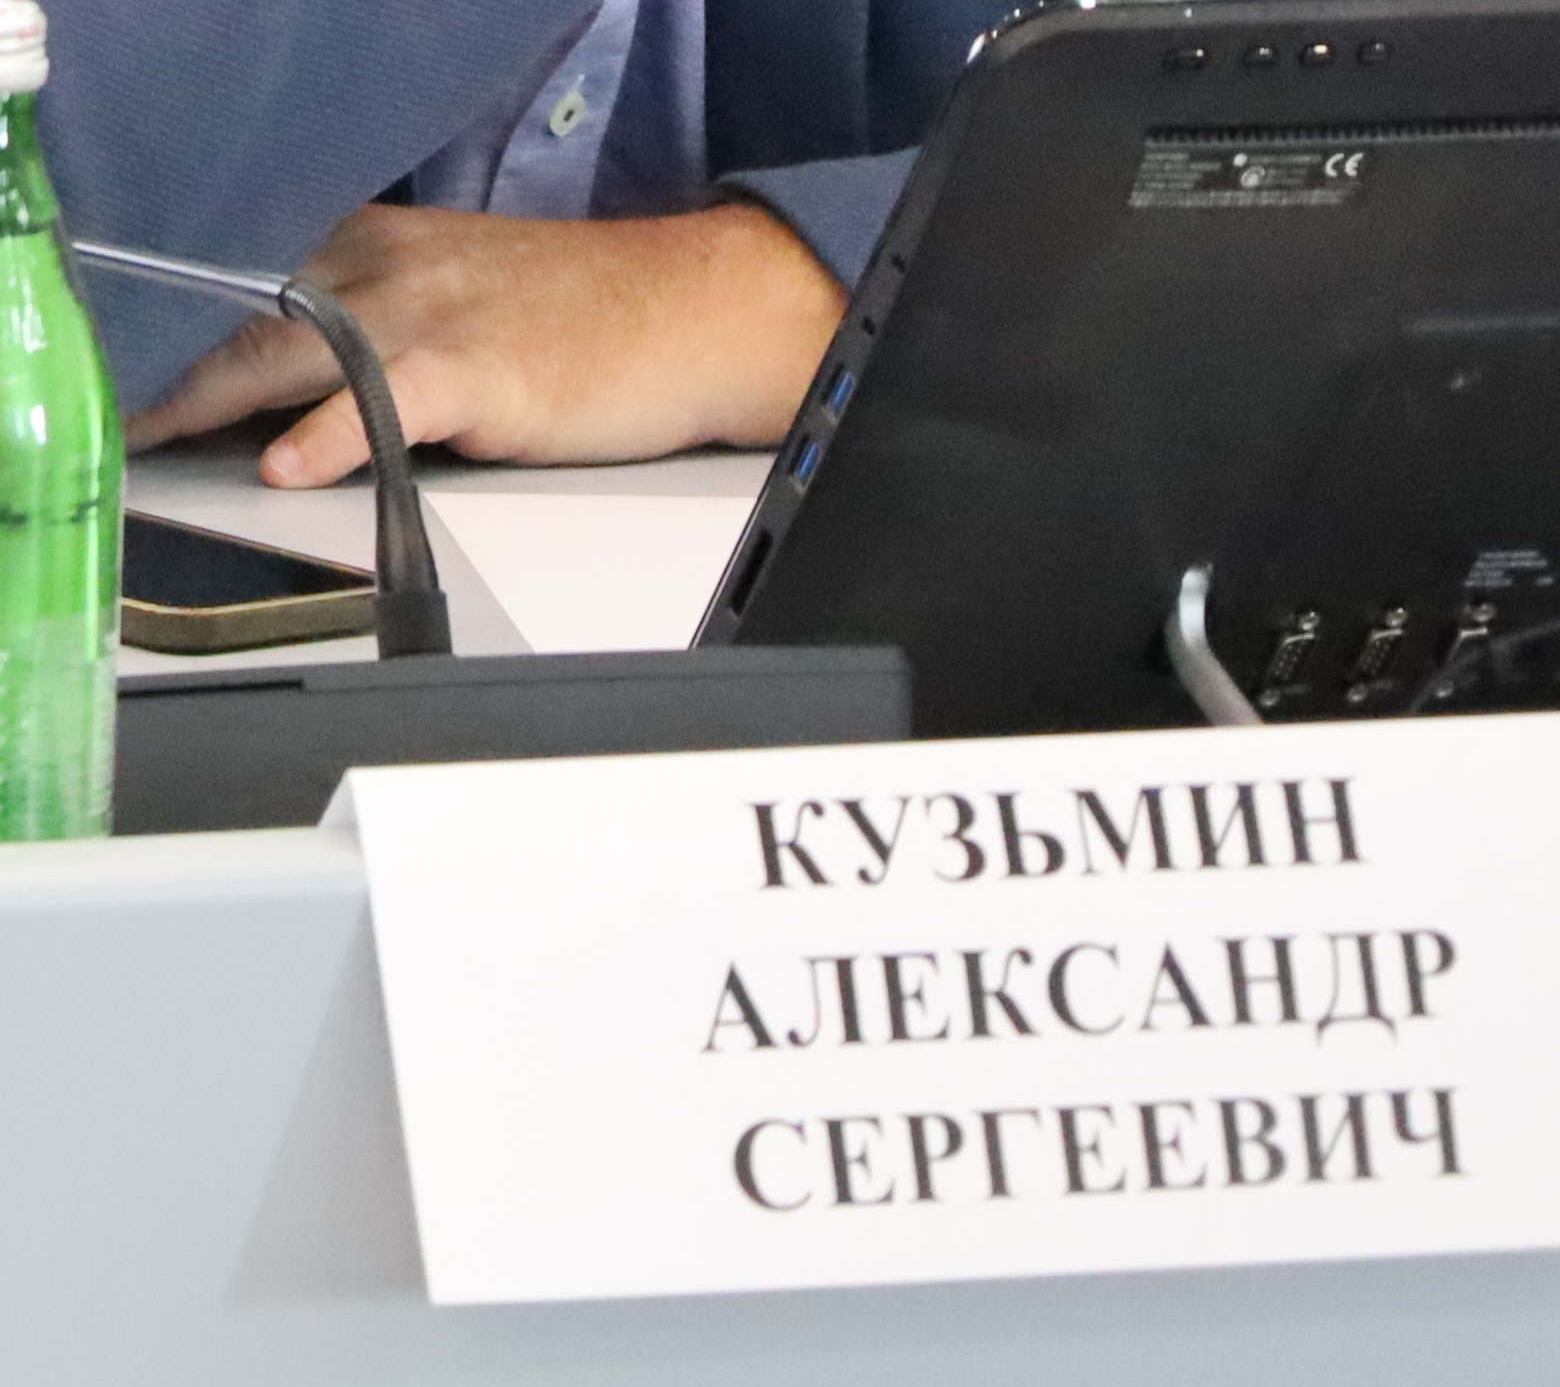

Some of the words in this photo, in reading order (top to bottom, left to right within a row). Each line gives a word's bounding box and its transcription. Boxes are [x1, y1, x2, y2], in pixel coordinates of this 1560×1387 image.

[752, 778, 1364, 890] КУЗЬМИН
[704, 930, 1456, 1052] АЛЕКСАНДР
[733, 1087, 1465, 1211] СЕРГЕЕВИЧ
